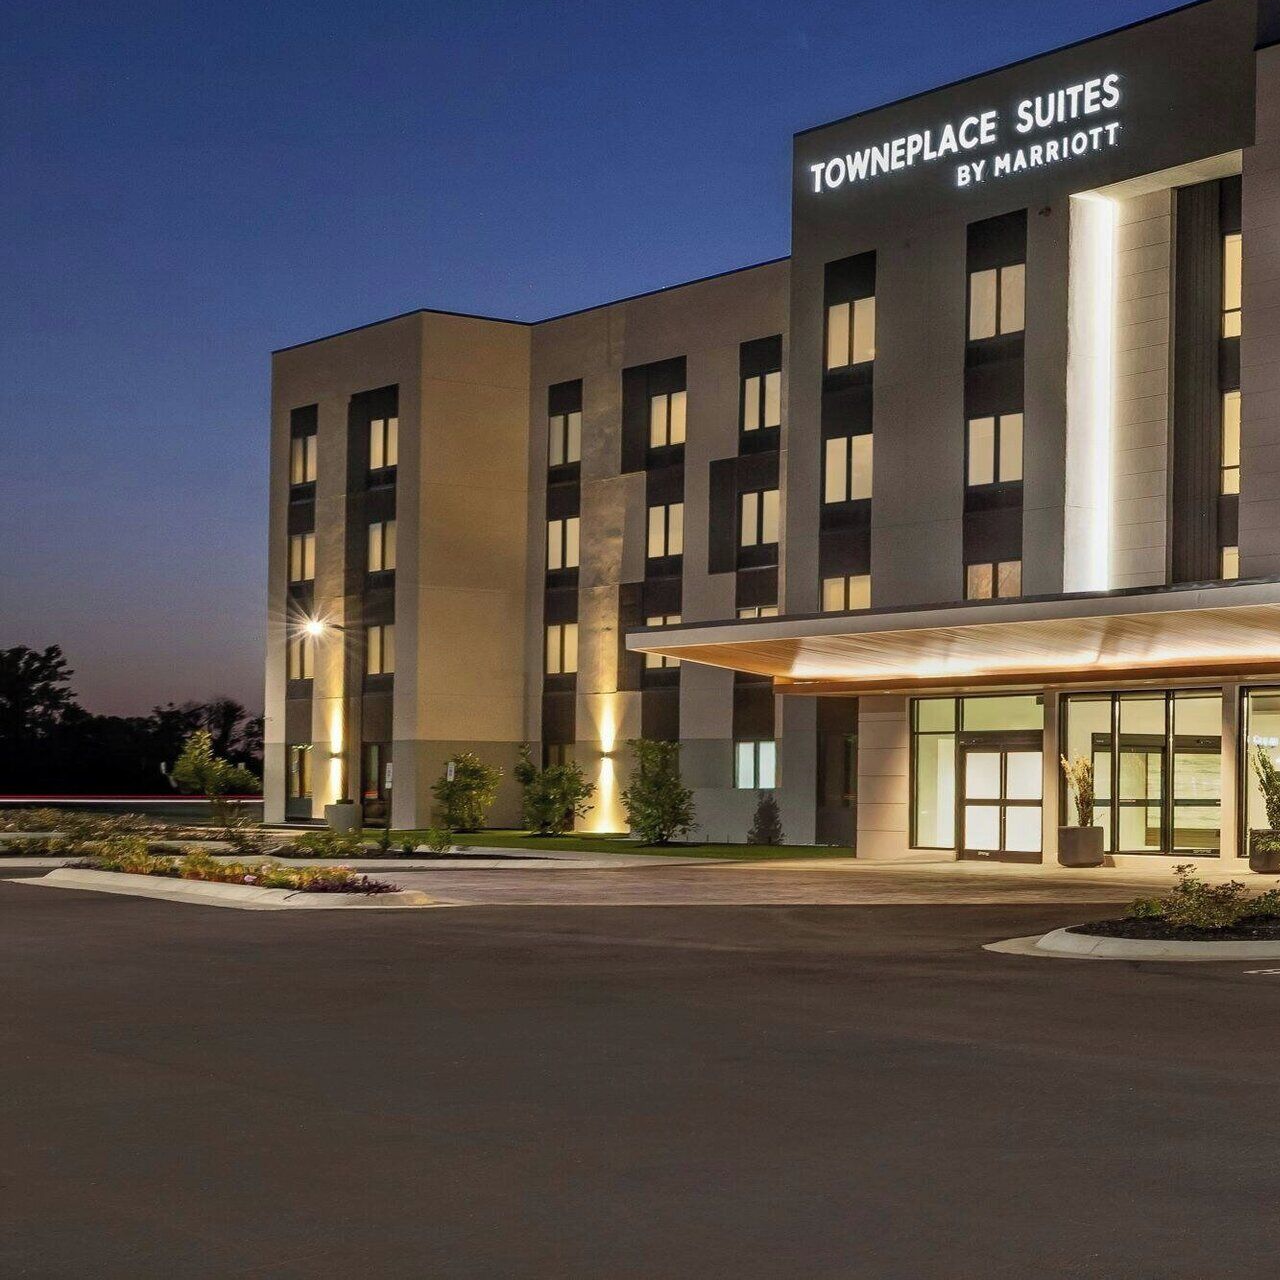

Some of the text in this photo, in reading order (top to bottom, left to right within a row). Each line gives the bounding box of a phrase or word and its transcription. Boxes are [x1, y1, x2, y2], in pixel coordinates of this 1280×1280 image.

[809, 72, 1121, 194] TOWNEPLACE SUITES
[956, 120, 1121, 187] BY MARRIOTT
